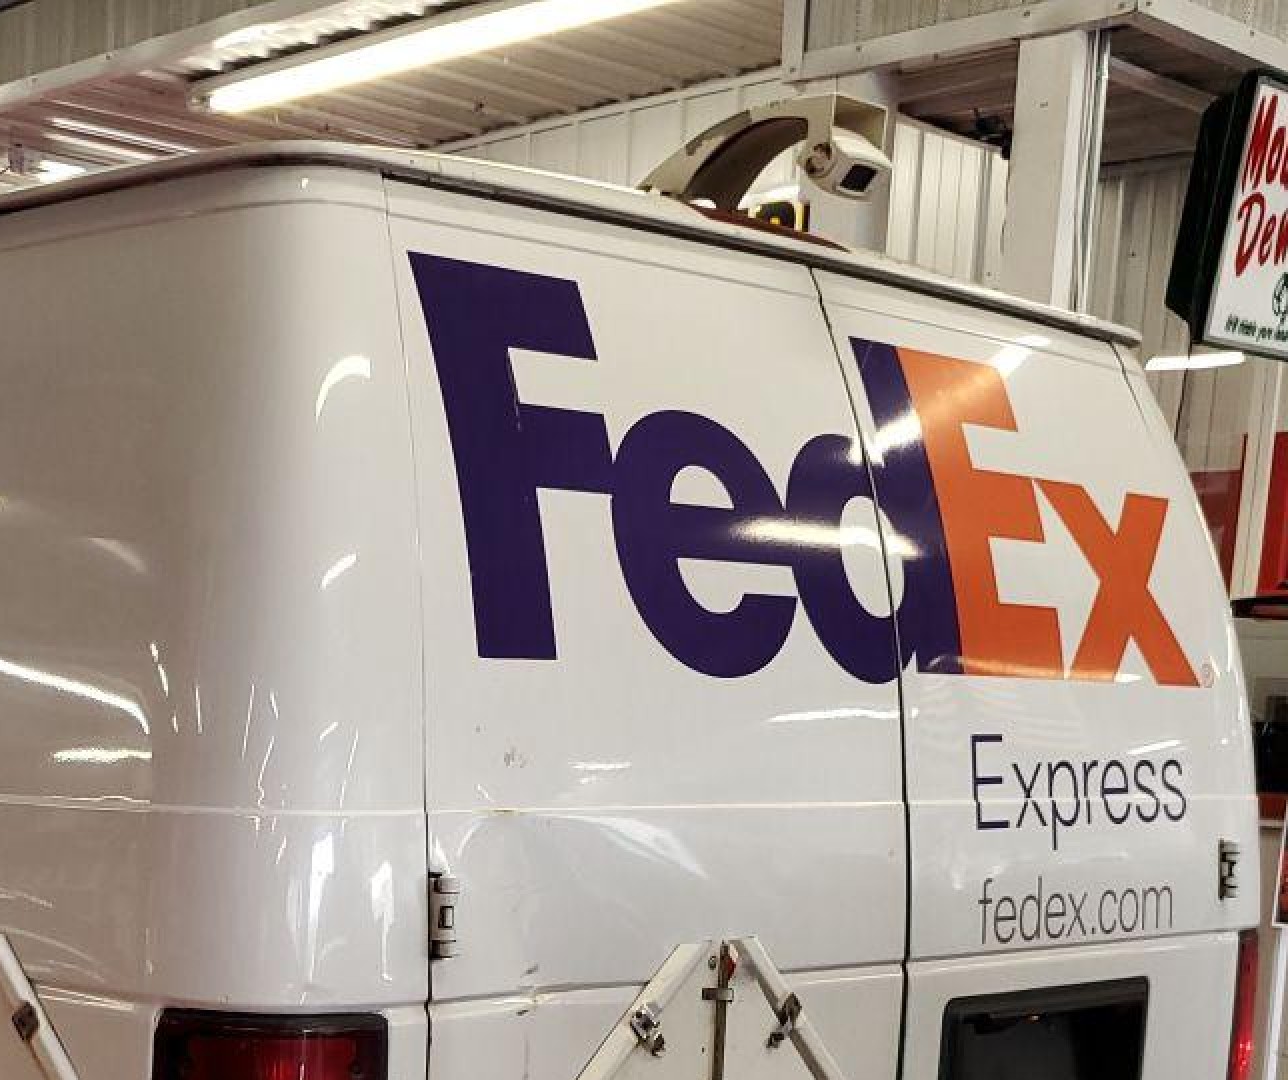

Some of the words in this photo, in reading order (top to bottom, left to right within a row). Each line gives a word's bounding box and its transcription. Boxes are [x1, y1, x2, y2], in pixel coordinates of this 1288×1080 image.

[407, 251, 1200, 686] FedEx
[970, 734, 1187, 850] Express
[977, 876, 1173, 945] fedex.com
